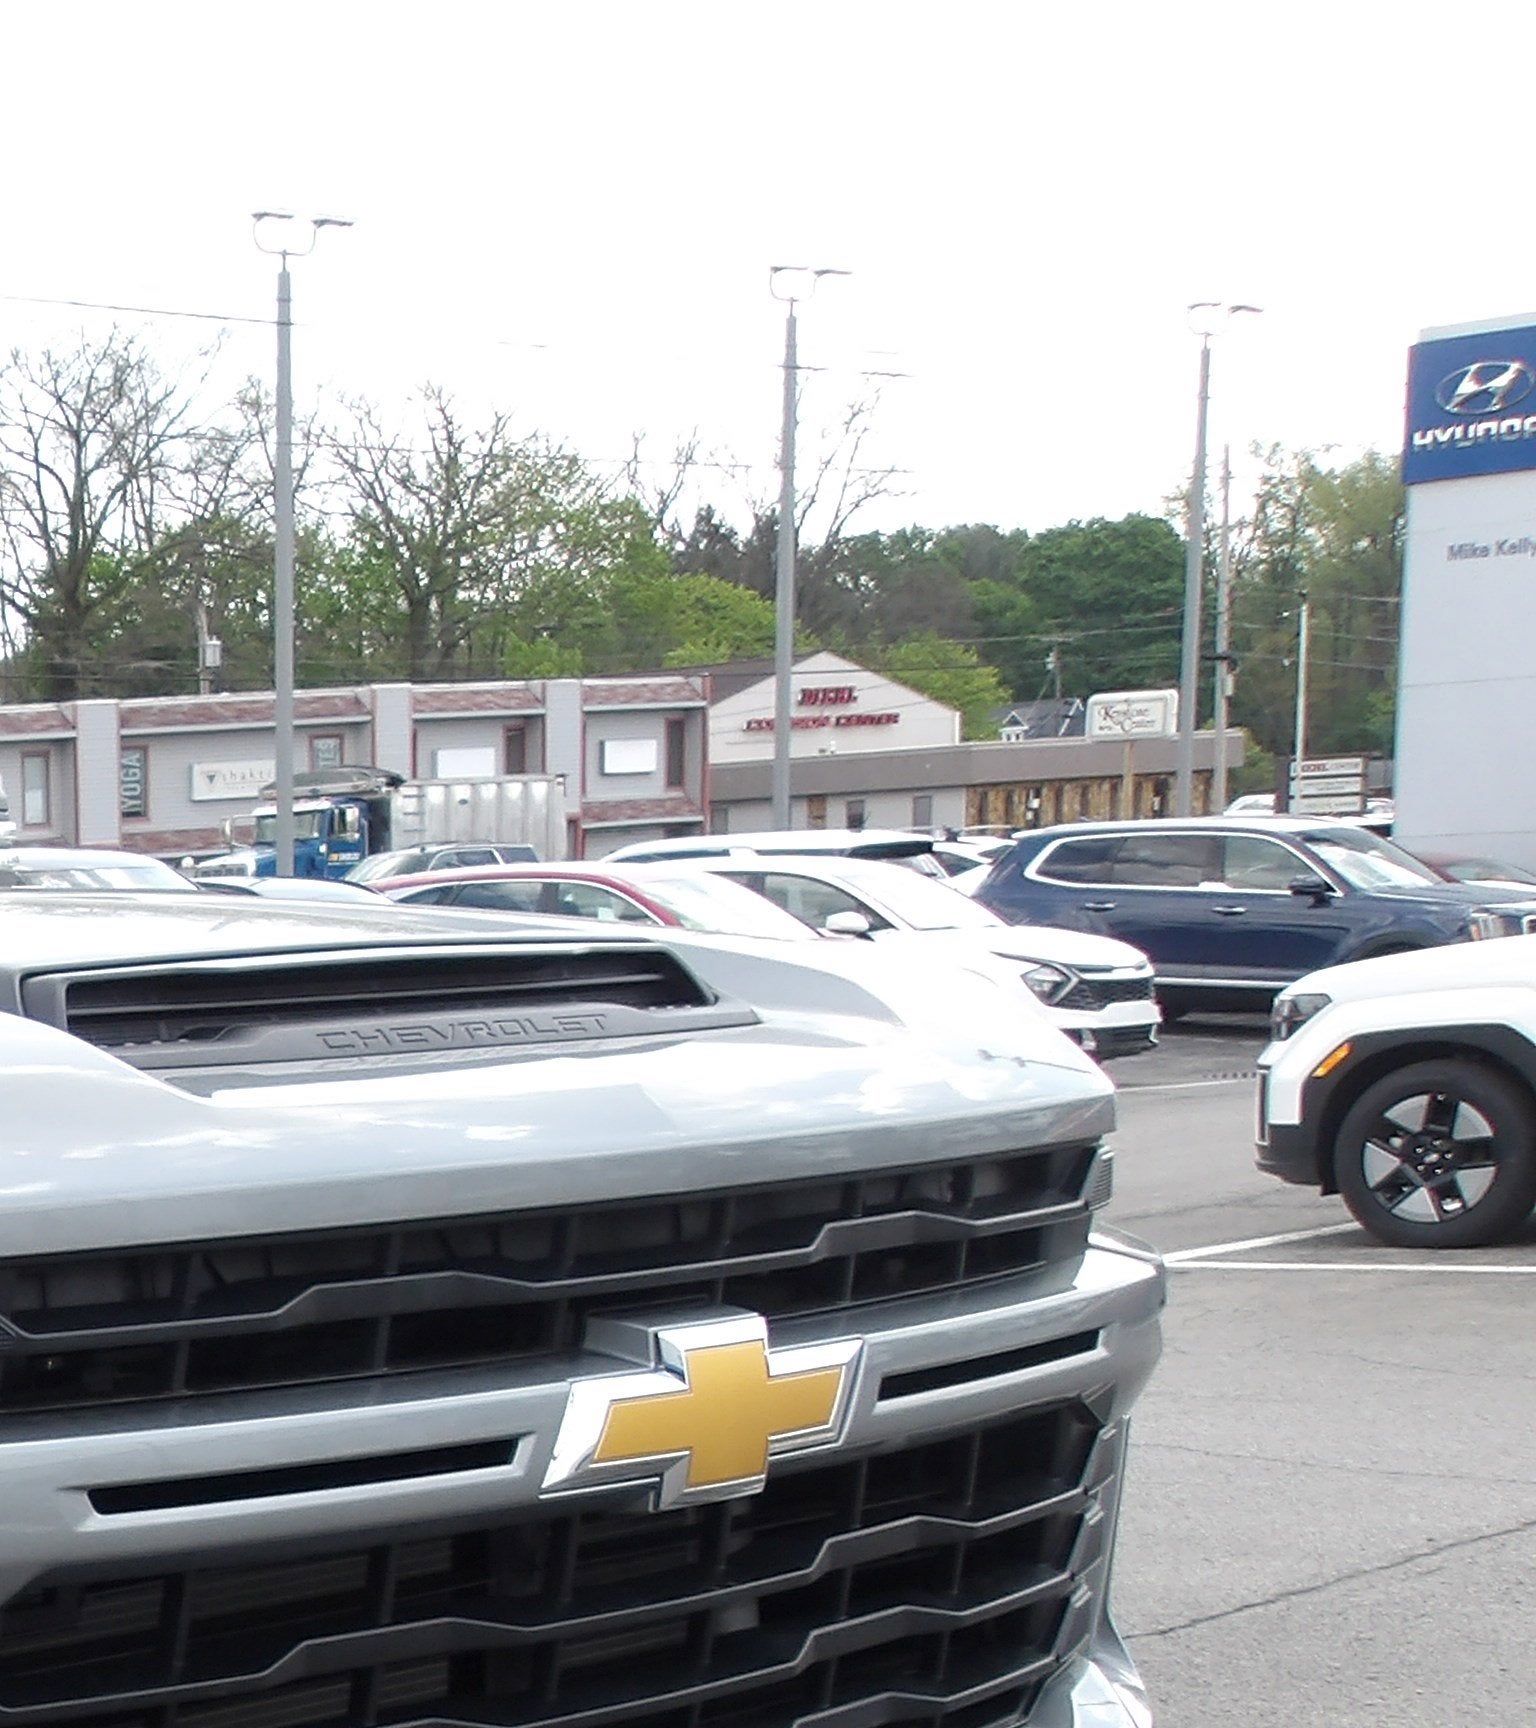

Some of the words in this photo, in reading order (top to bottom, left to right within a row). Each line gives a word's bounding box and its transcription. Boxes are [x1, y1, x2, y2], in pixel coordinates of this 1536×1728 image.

[1447, 542, 1490, 561] Mike
[121, 752, 142, 812] YOGA
[315, 1013, 607, 1051] CHEVROLET
